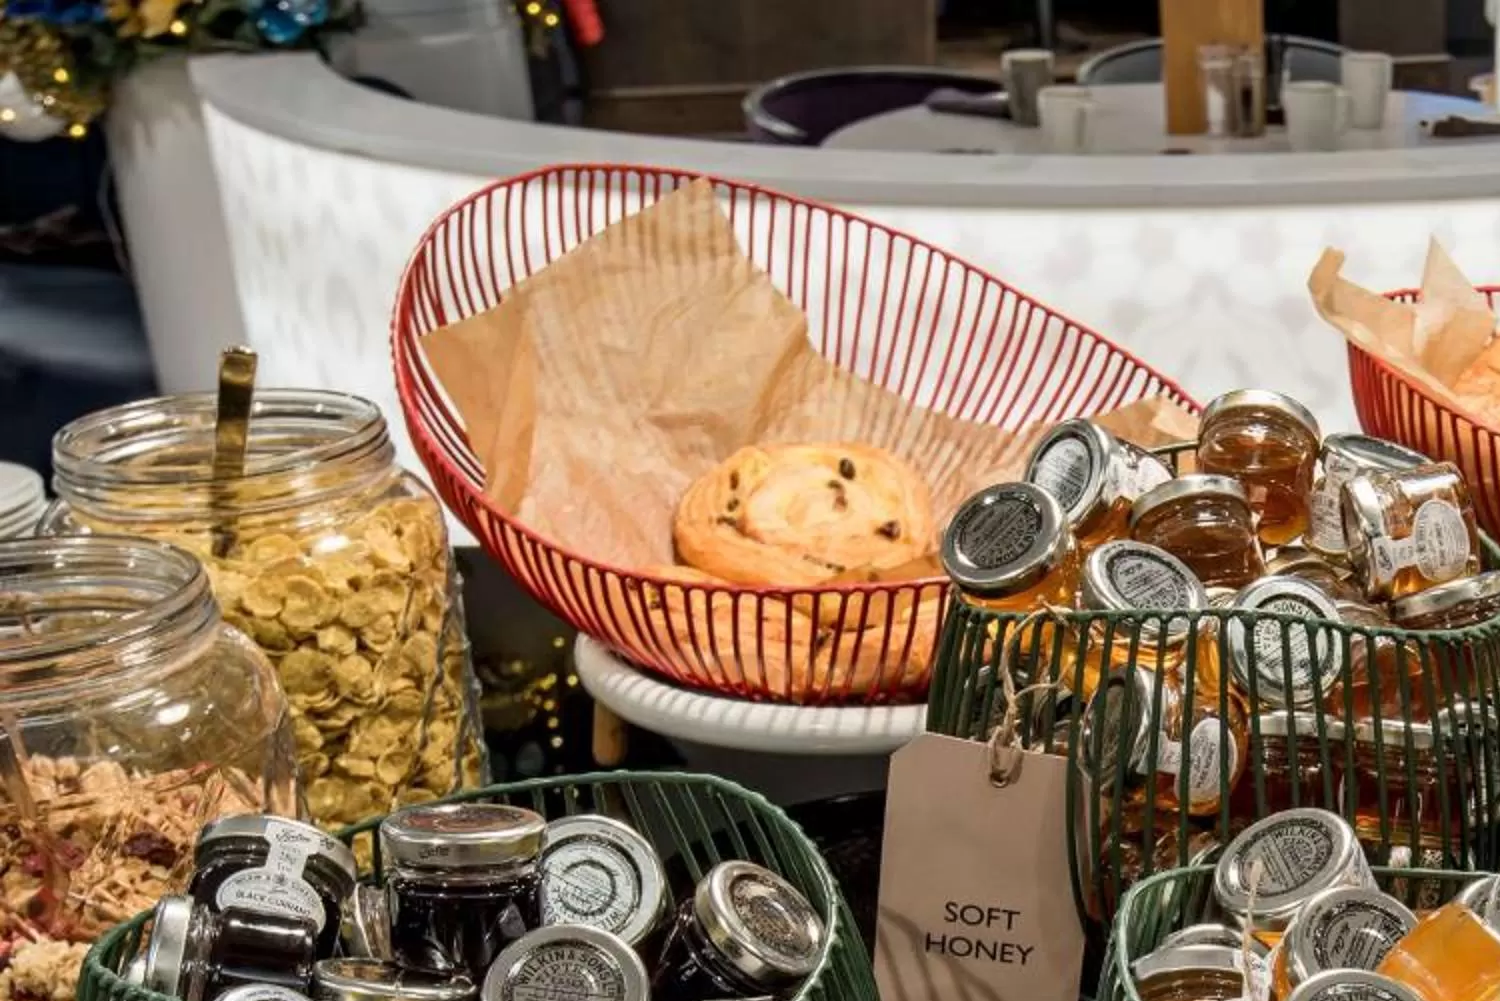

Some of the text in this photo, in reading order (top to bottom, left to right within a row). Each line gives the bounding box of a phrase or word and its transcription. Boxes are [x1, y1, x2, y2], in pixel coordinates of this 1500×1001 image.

[944, 901, 1020, 930] SOFT
[925, 932, 1034, 965] HONEY
[520, 950, 565, 984] WILKIN
[579, 953, 612, 981] SONS
